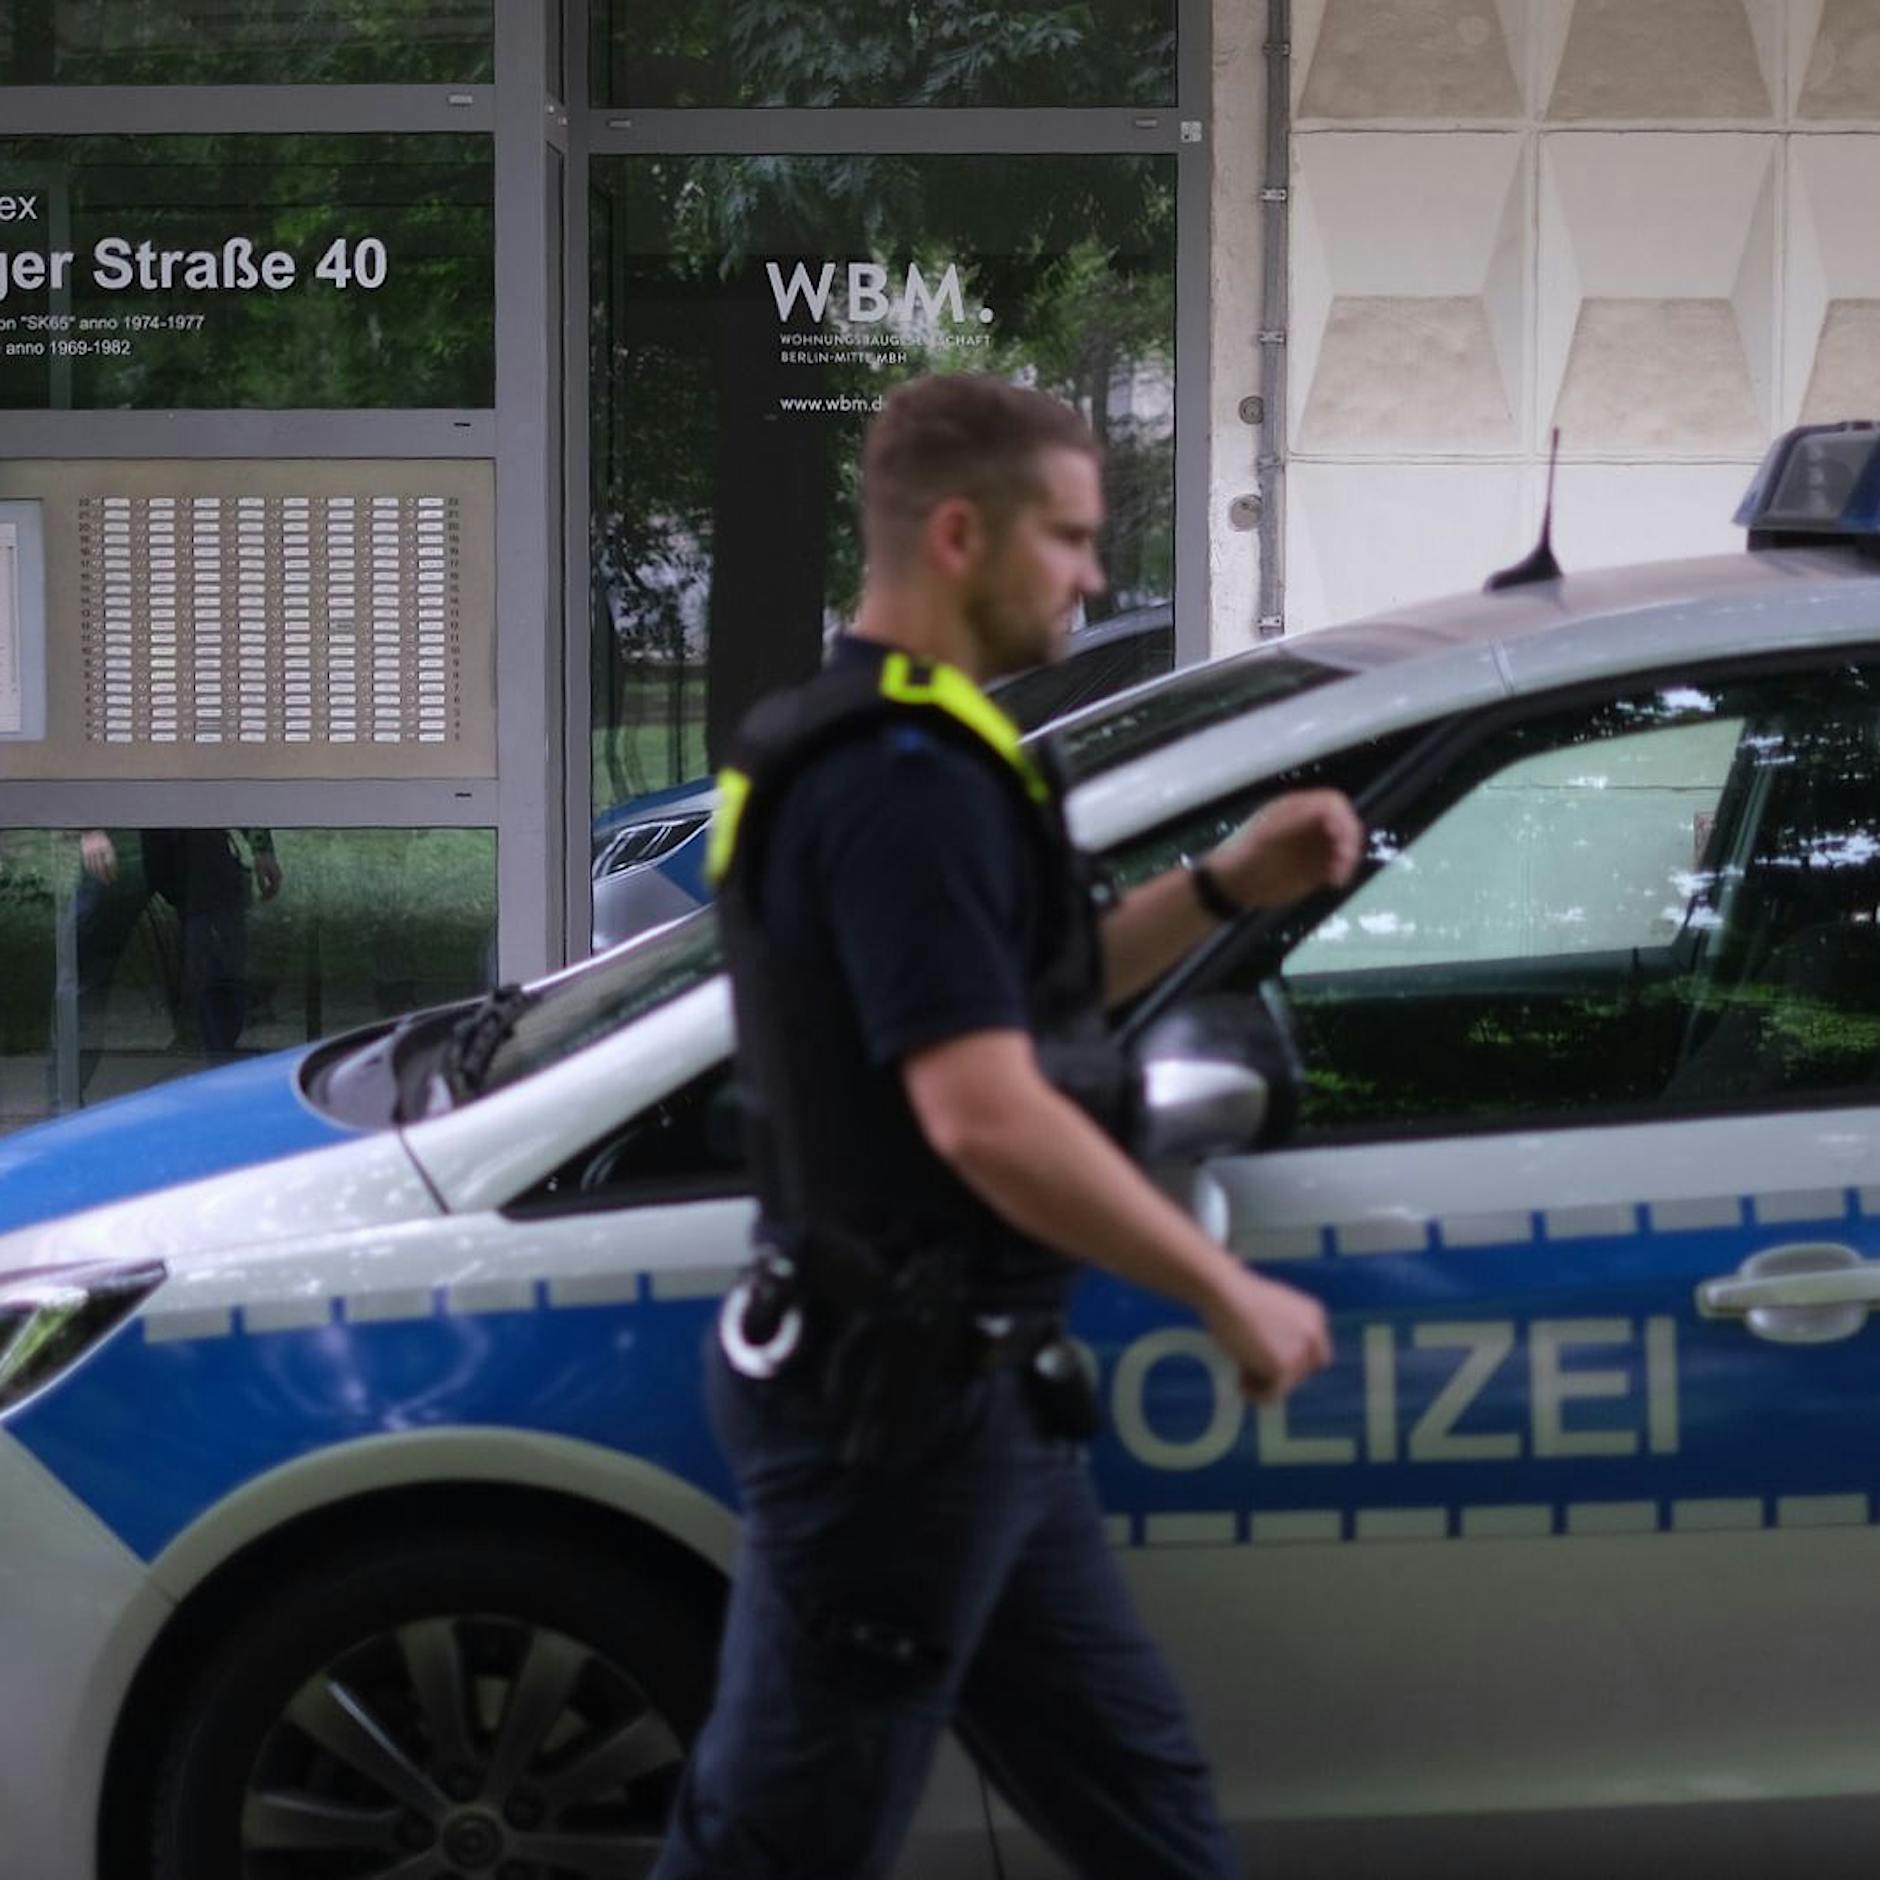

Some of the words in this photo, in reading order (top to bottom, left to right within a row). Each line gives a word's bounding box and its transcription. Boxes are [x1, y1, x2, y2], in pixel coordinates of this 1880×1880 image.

[0, 195, 38, 220] ex
[0, 250, 74, 300] er
[93, 236, 295, 290] Straße
[315, 237, 387, 289] 40
[765, 262, 994, 323] WBM.
[79, 317, 119, 331] anno
[124, 315, 205, 331] 1974-1977
[6, 342, 45, 356] anno
[51, 340, 131, 356] 1969-1982
[779, 333, 992, 347] WOHNUNGSBAUGESCHAFT
[780, 394, 887, 412] www.wbm.d
[1070, 1315, 1682, 1471] OLIZEI
